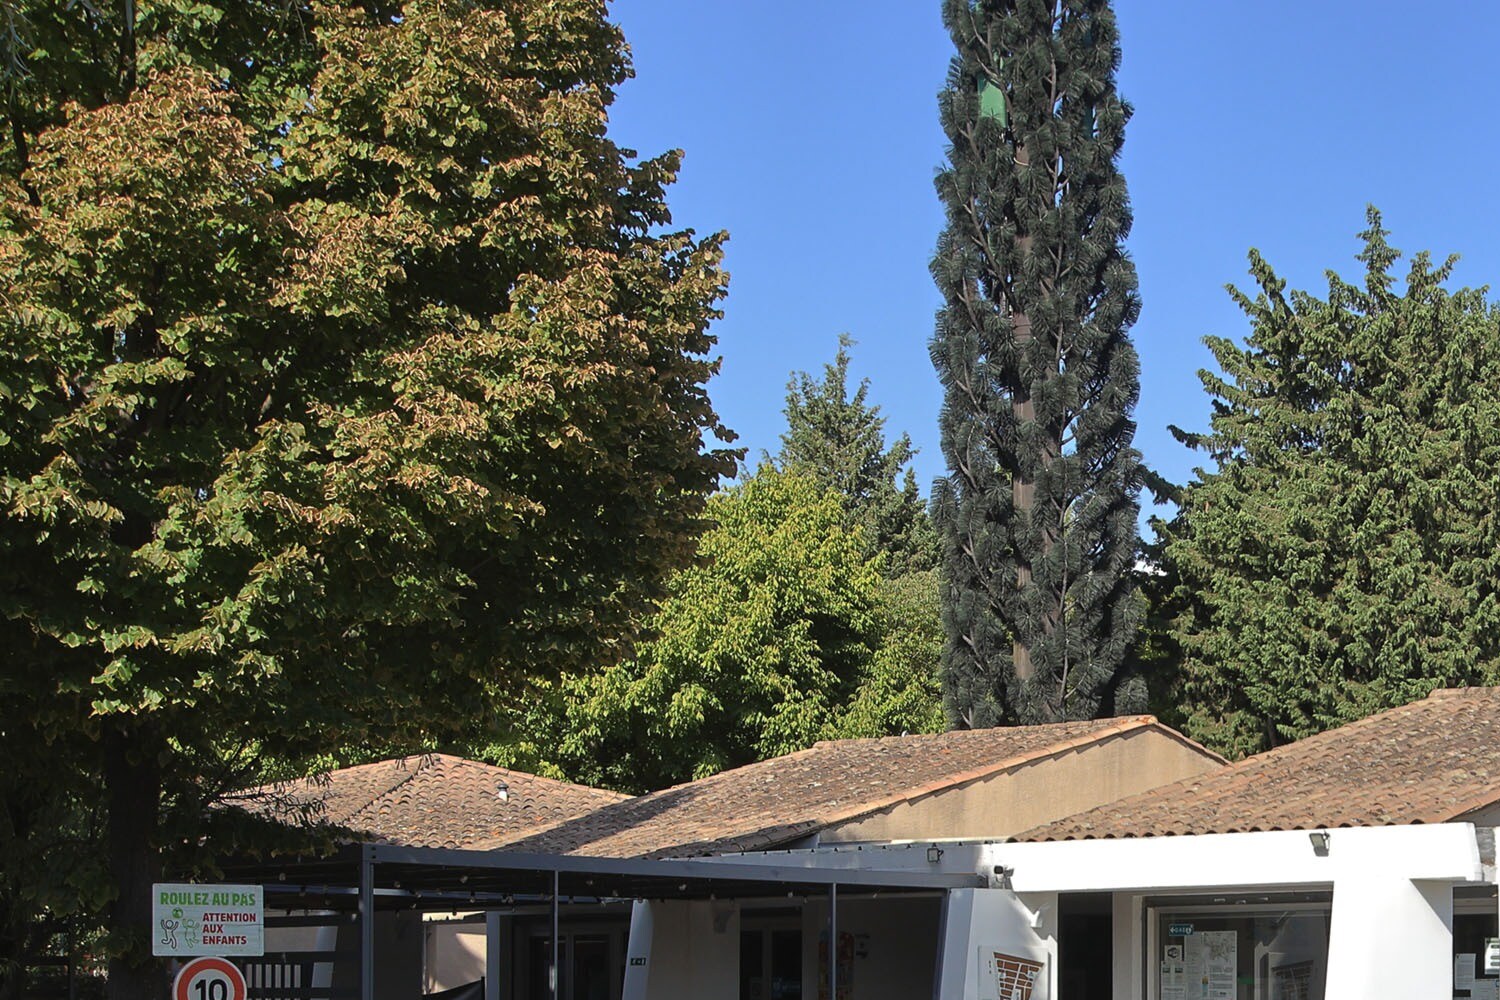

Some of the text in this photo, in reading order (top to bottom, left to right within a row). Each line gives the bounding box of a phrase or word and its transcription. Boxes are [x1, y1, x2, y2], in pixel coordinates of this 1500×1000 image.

[160, 892, 256, 906] ROULEZ AU PAS
[202, 912, 256, 922] ATTENTION
[202, 924, 224, 933] AUX
[202, 936, 247, 945] ENFANTS
